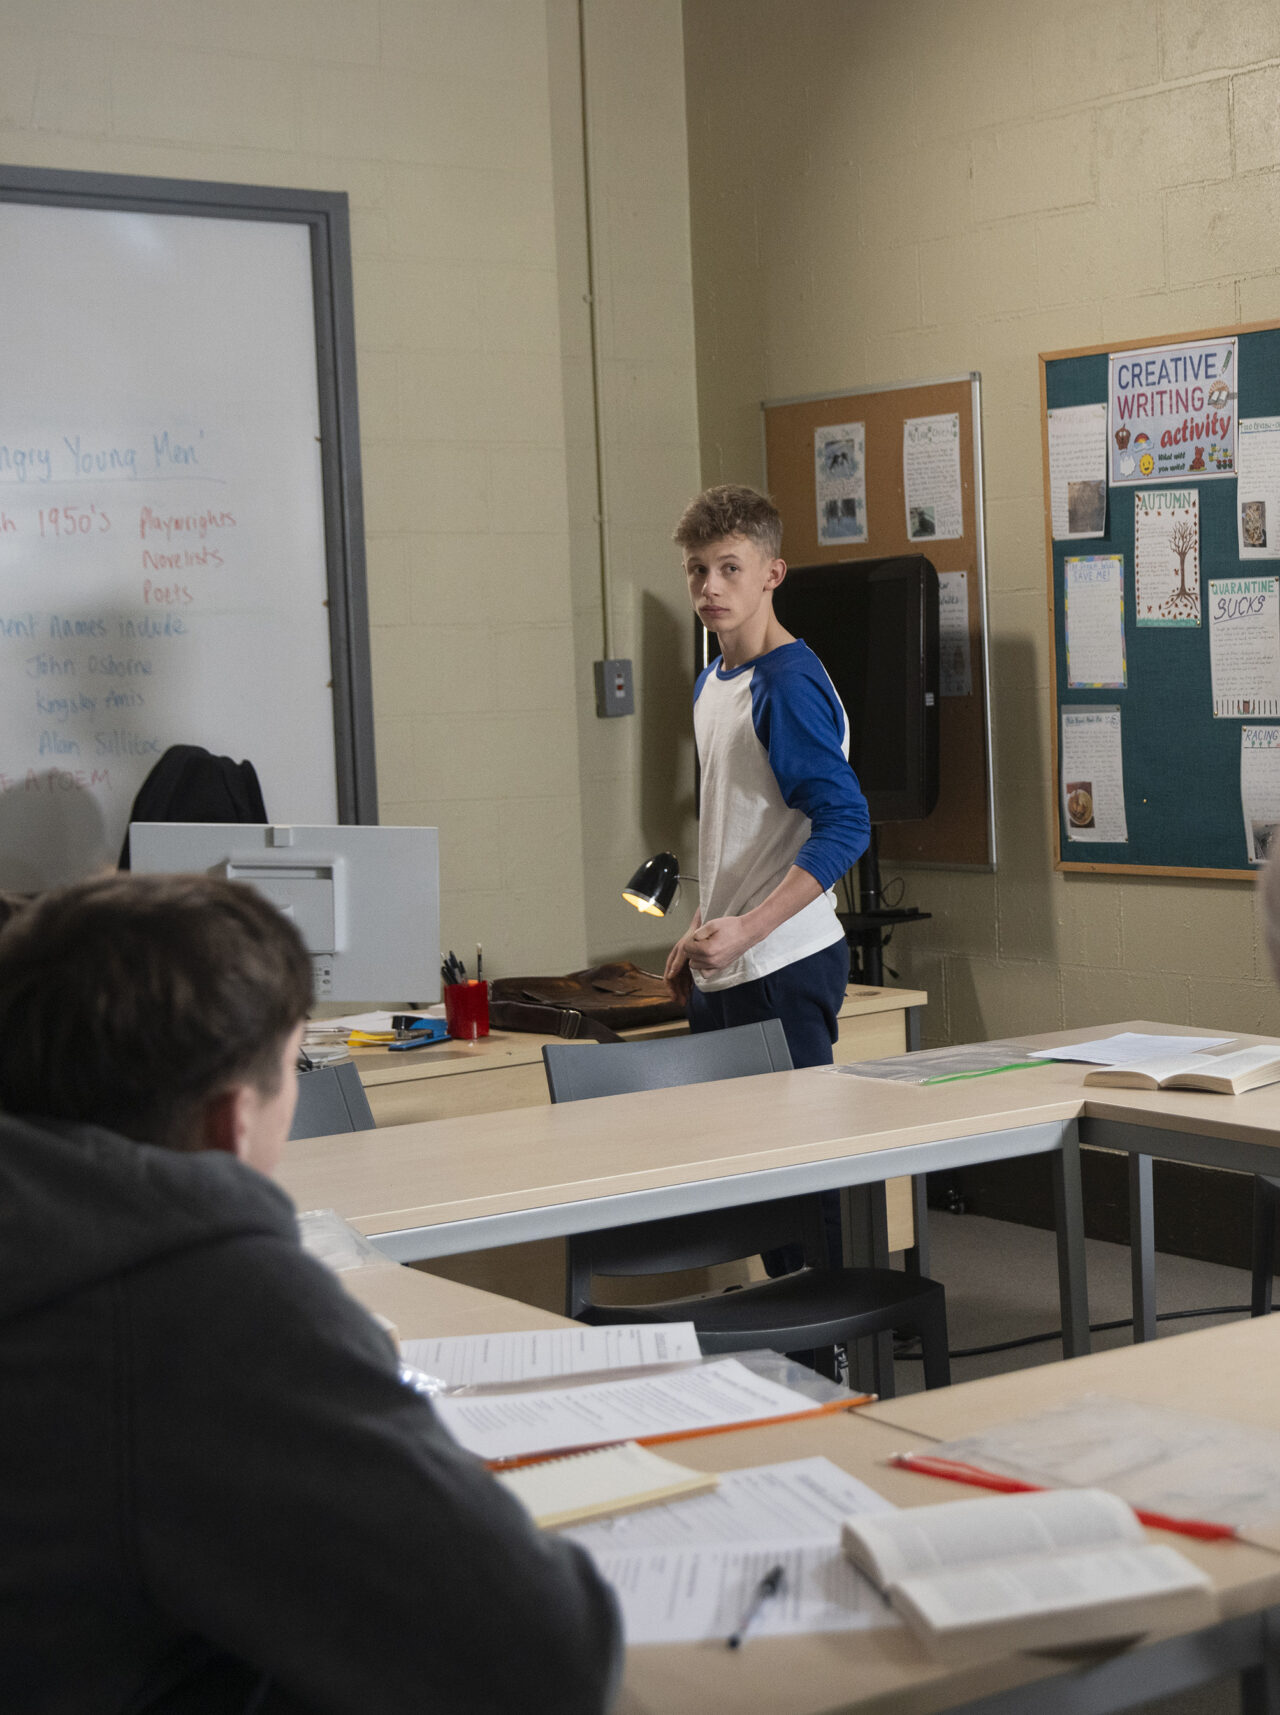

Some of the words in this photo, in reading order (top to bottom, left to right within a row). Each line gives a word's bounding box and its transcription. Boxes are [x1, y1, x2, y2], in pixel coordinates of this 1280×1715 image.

[1118, 352, 1218, 390] CREATIVE
[1117, 386, 1205, 420] WRITING
[1160, 412, 1232, 448] activity
[63, 434, 138, 475] Young
[1139, 491, 1193, 511] AUTUMN
[38, 504, 111, 539] 1950's
[1211, 580, 1275, 596] QUARANTINE
[1214, 595, 1266, 620] SUCKS
[1244, 729, 1279, 742] RACING
